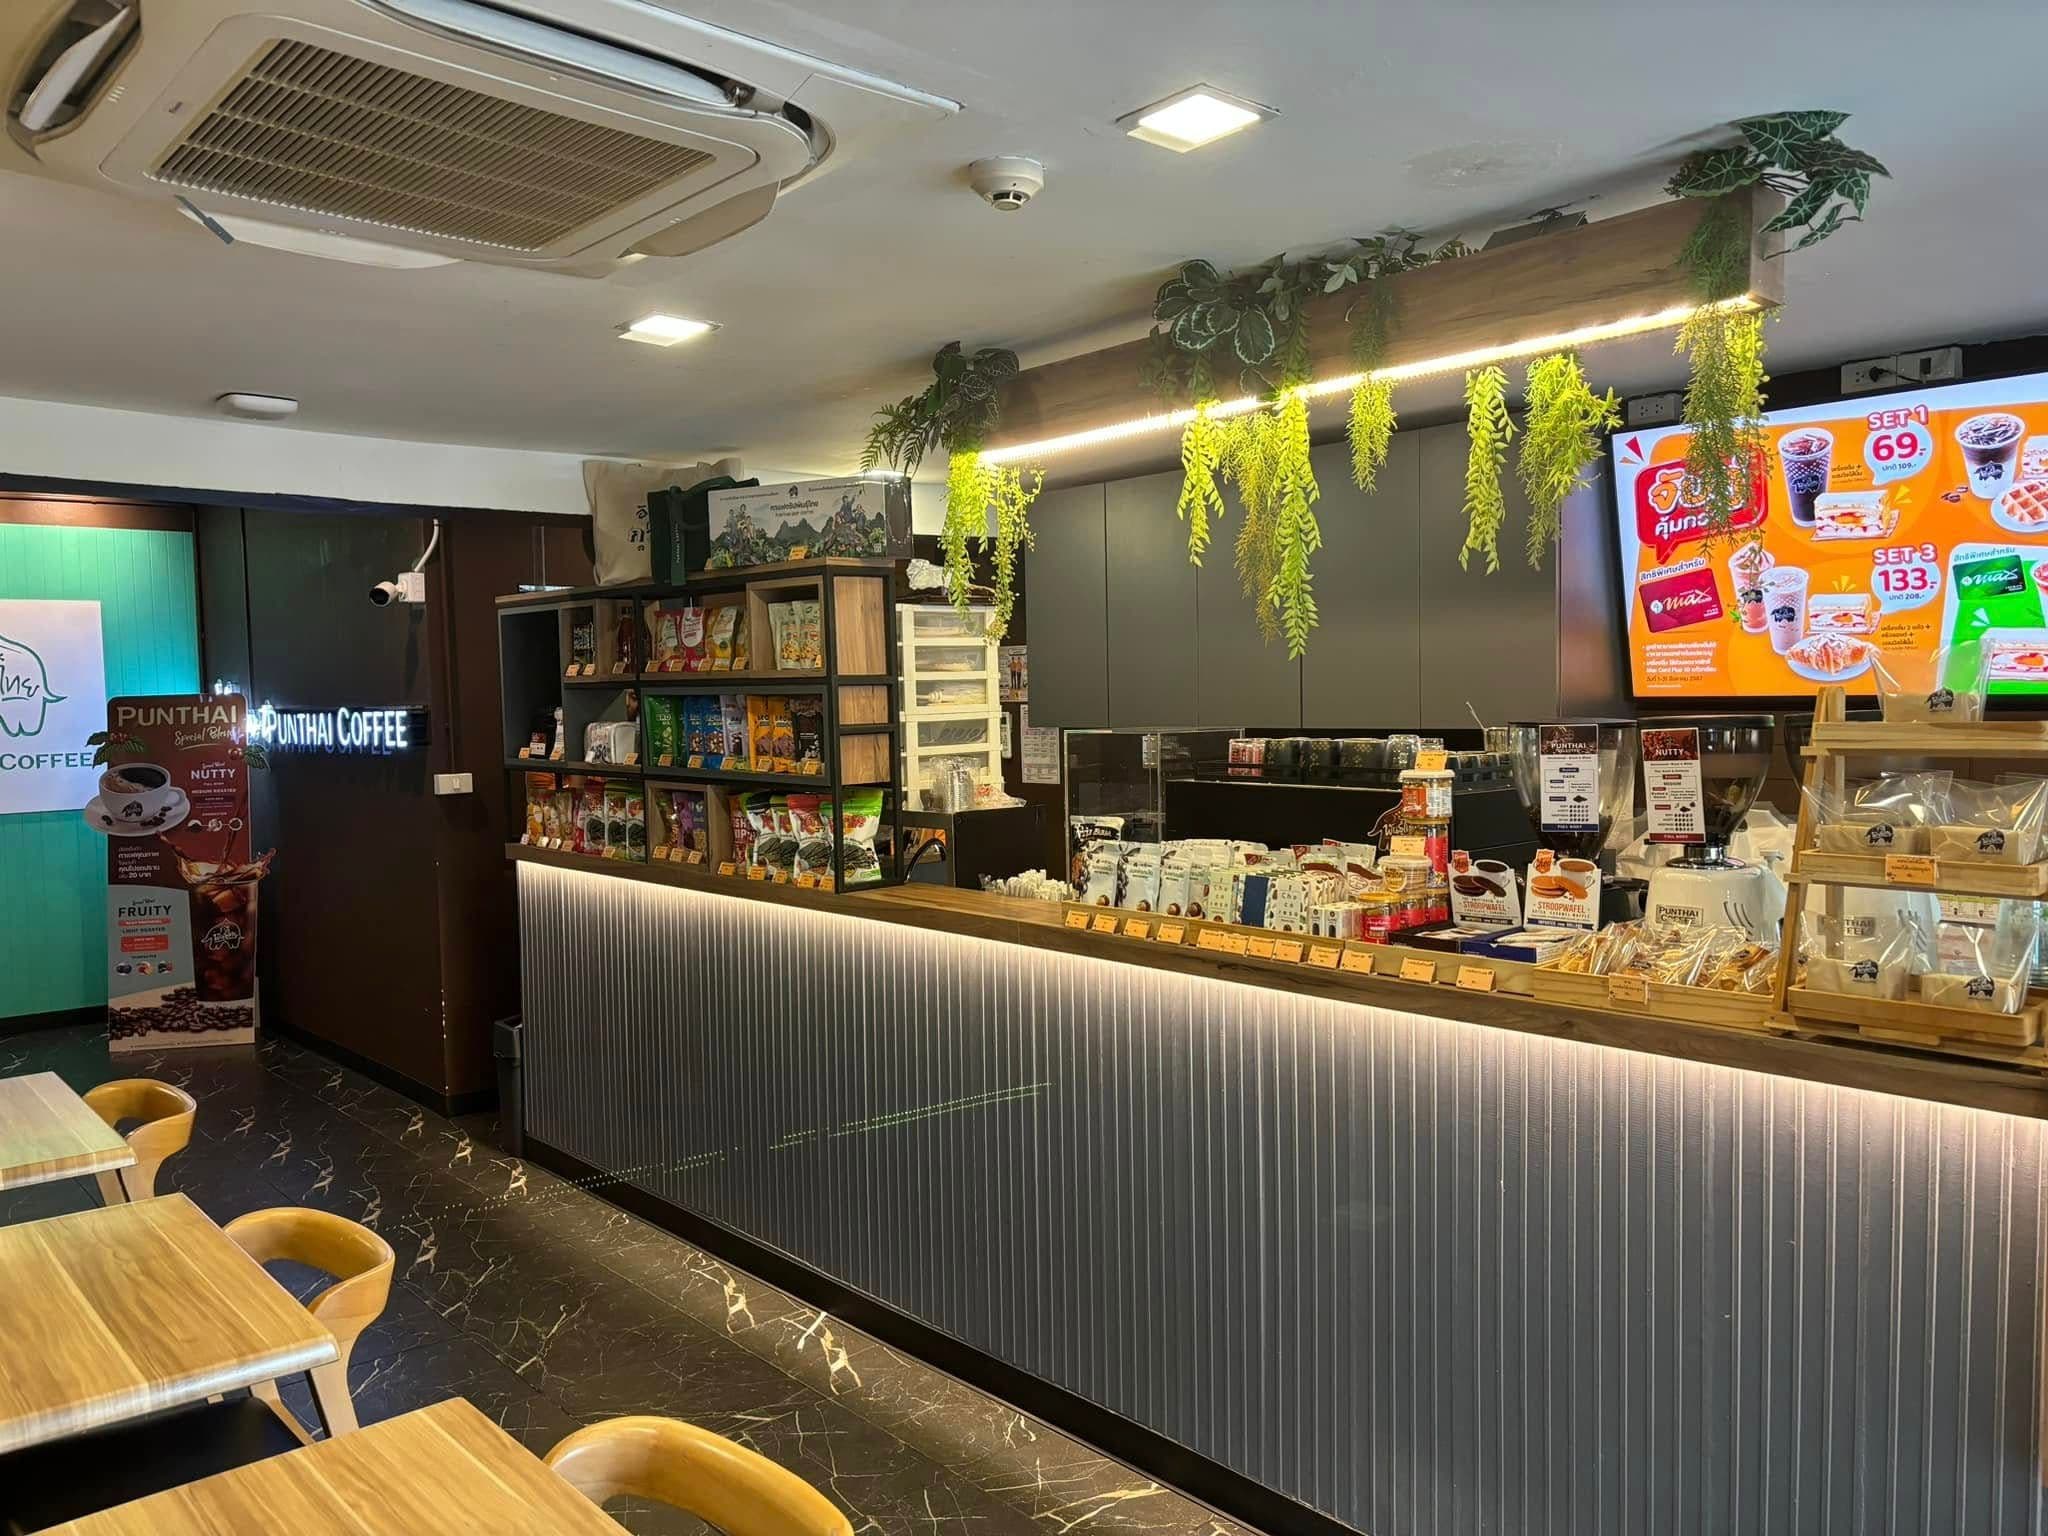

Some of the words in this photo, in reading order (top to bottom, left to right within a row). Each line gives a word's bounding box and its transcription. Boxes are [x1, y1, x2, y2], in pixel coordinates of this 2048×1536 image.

[1867, 409, 1911, 431] SET
[1914, 404, 1928, 425] 1
[1873, 547, 1917, 566] SET
[1920, 543, 1938, 563] 3
[117, 705, 237, 727] PUNTHAI
[267, 709, 333, 745] PUNTHAI
[337, 706, 408, 748] COFFEE
[174, 729, 206, 746] Special
[1655, 748, 1685, 756] NUTTY
[0, 752, 92, 771] COFFEE
[191, 769, 236, 780] NUTTY
[118, 905, 172, 918] FRUITY
[1462, 901, 1506, 912] STROOPWAFEL
[1537, 901, 1586, 913] STROOPWAFEL
[1659, 906, 1699, 918] PUNTHAI
